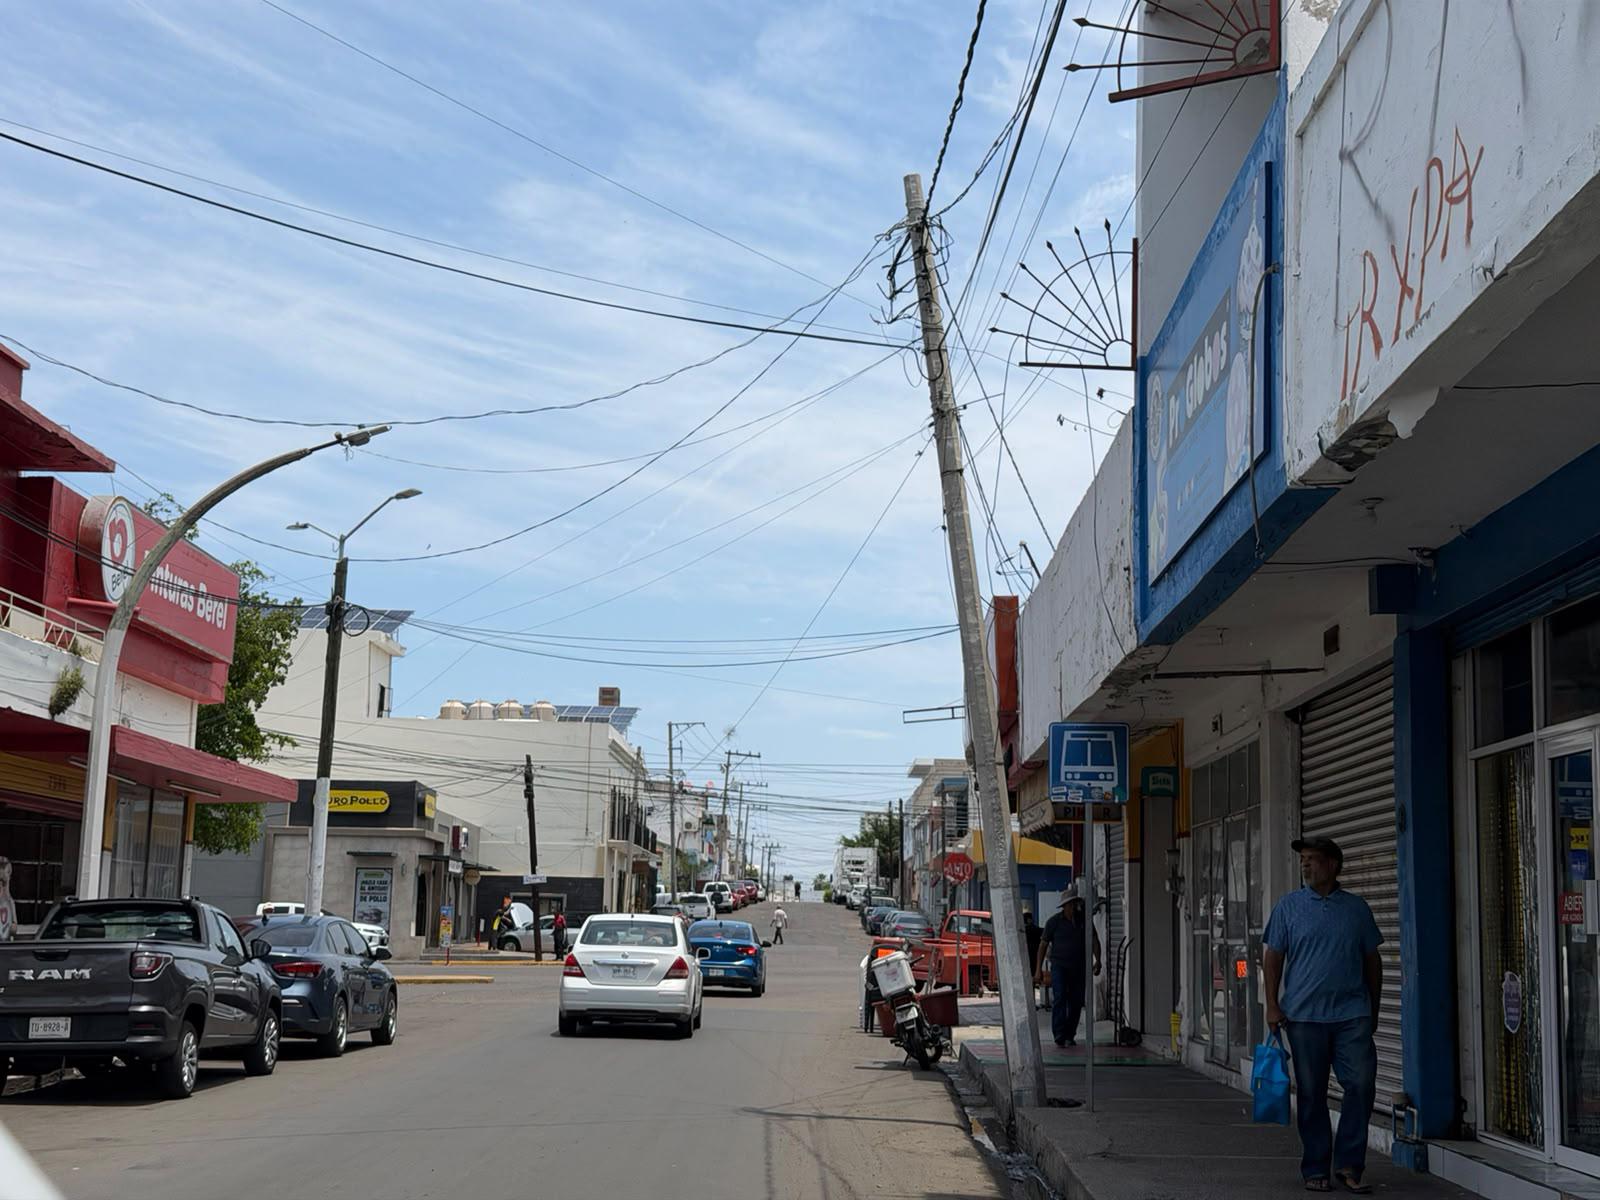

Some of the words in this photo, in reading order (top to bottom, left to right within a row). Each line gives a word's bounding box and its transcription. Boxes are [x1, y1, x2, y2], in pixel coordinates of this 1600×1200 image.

[1185, 320, 1228, 420] Globos
[196, 582, 228, 630] Berel
[8, 968, 92, 981] RAM
